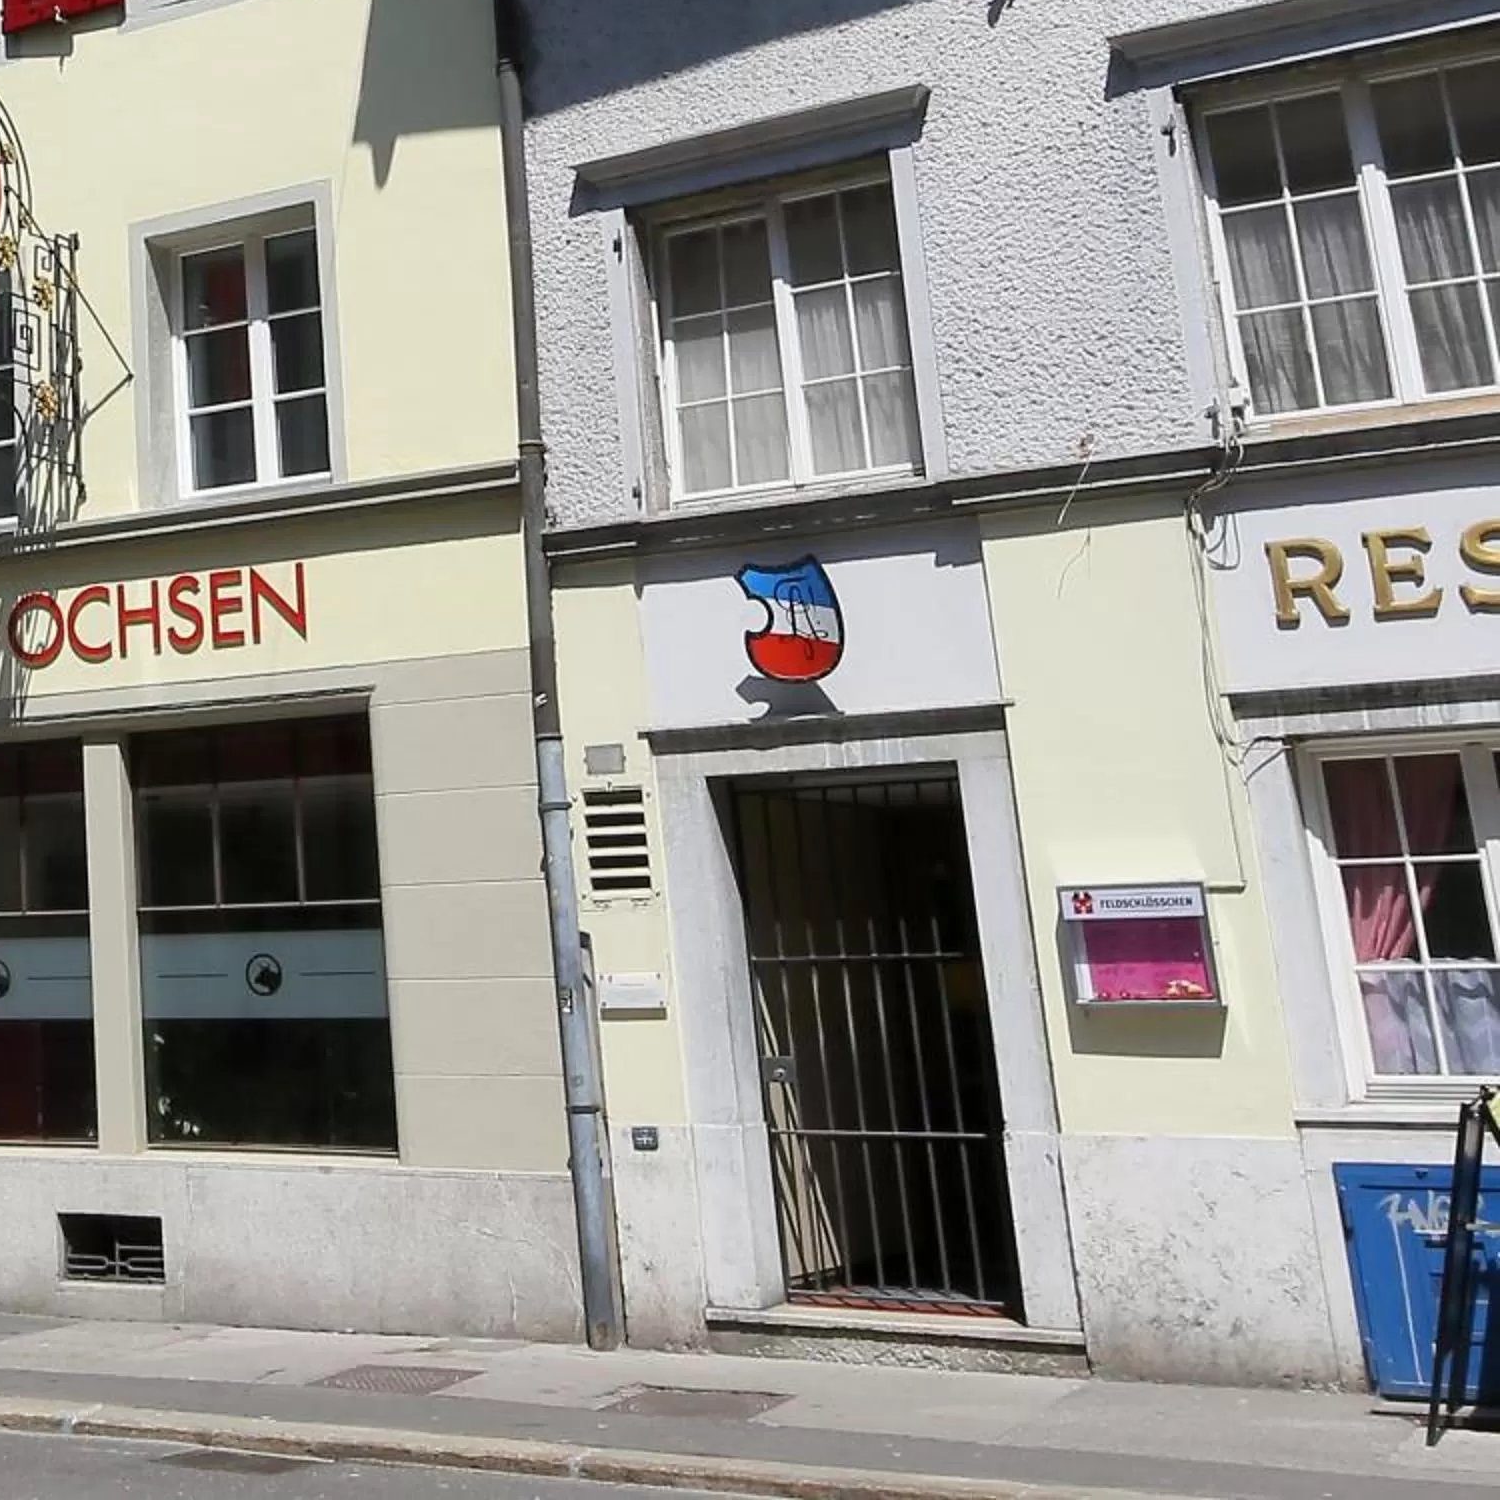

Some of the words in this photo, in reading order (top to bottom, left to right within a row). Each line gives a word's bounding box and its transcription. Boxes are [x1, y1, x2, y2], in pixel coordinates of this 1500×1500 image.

[8, 562, 308, 670] OCHSEN
[1264, 517, 1500, 630] RES
[1099, 895, 1194, 909] FELDSCHLÖSSCHEN
